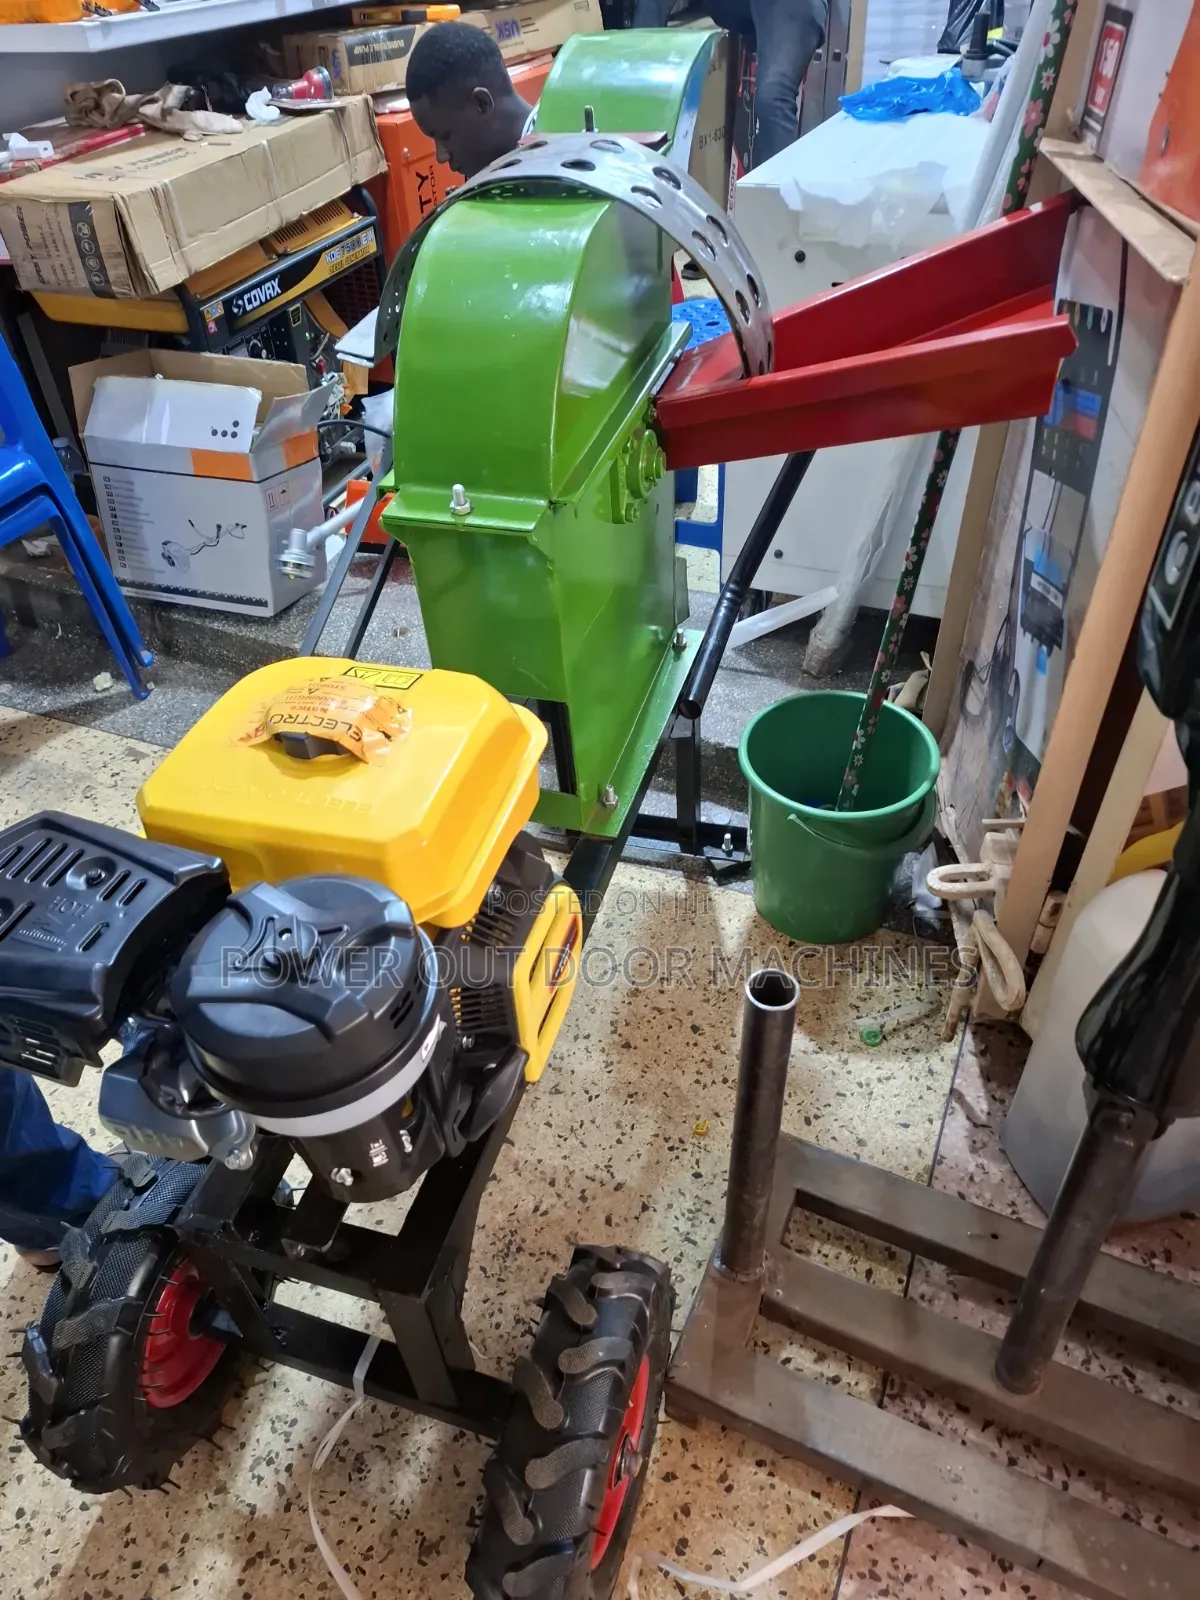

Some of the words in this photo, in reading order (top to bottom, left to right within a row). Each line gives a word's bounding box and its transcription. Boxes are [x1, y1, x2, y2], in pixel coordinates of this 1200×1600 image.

[416, 171, 431, 219] TY
[729, 163, 737, 211] EDON
[17, 205, 33, 250] POWER
[243, 277, 281, 311] COVAX
[270, 714, 363, 742] ELECTRO
[290, 705, 328, 713] NOTICE
